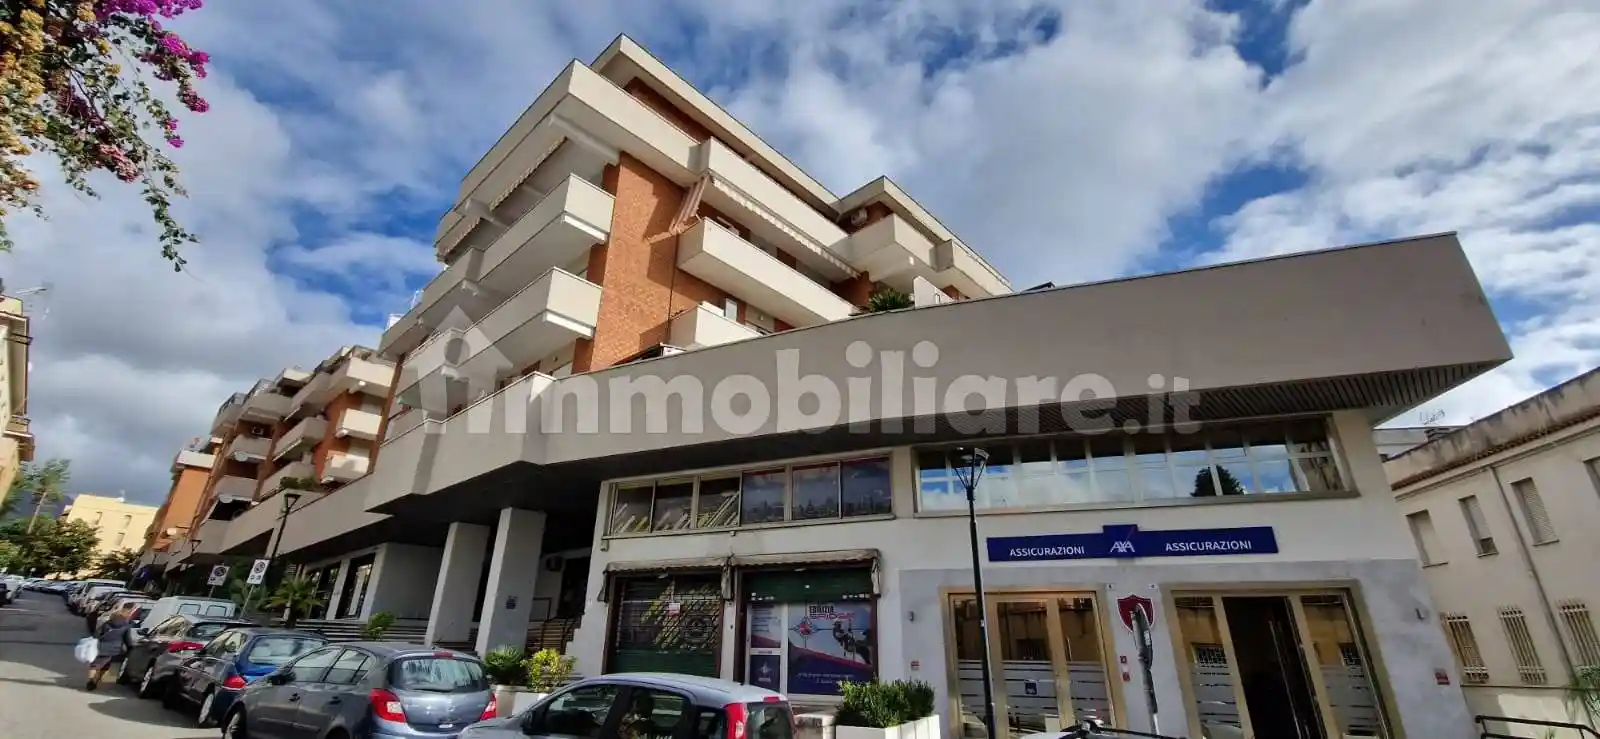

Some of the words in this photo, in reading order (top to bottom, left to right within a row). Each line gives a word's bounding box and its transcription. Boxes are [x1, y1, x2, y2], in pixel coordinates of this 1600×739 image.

[1009, 546, 1086, 557] ASSICURAZIONI
[1110, 540, 1136, 553] AXA
[1165, 539, 1253, 552] ASSICURAZIONI
